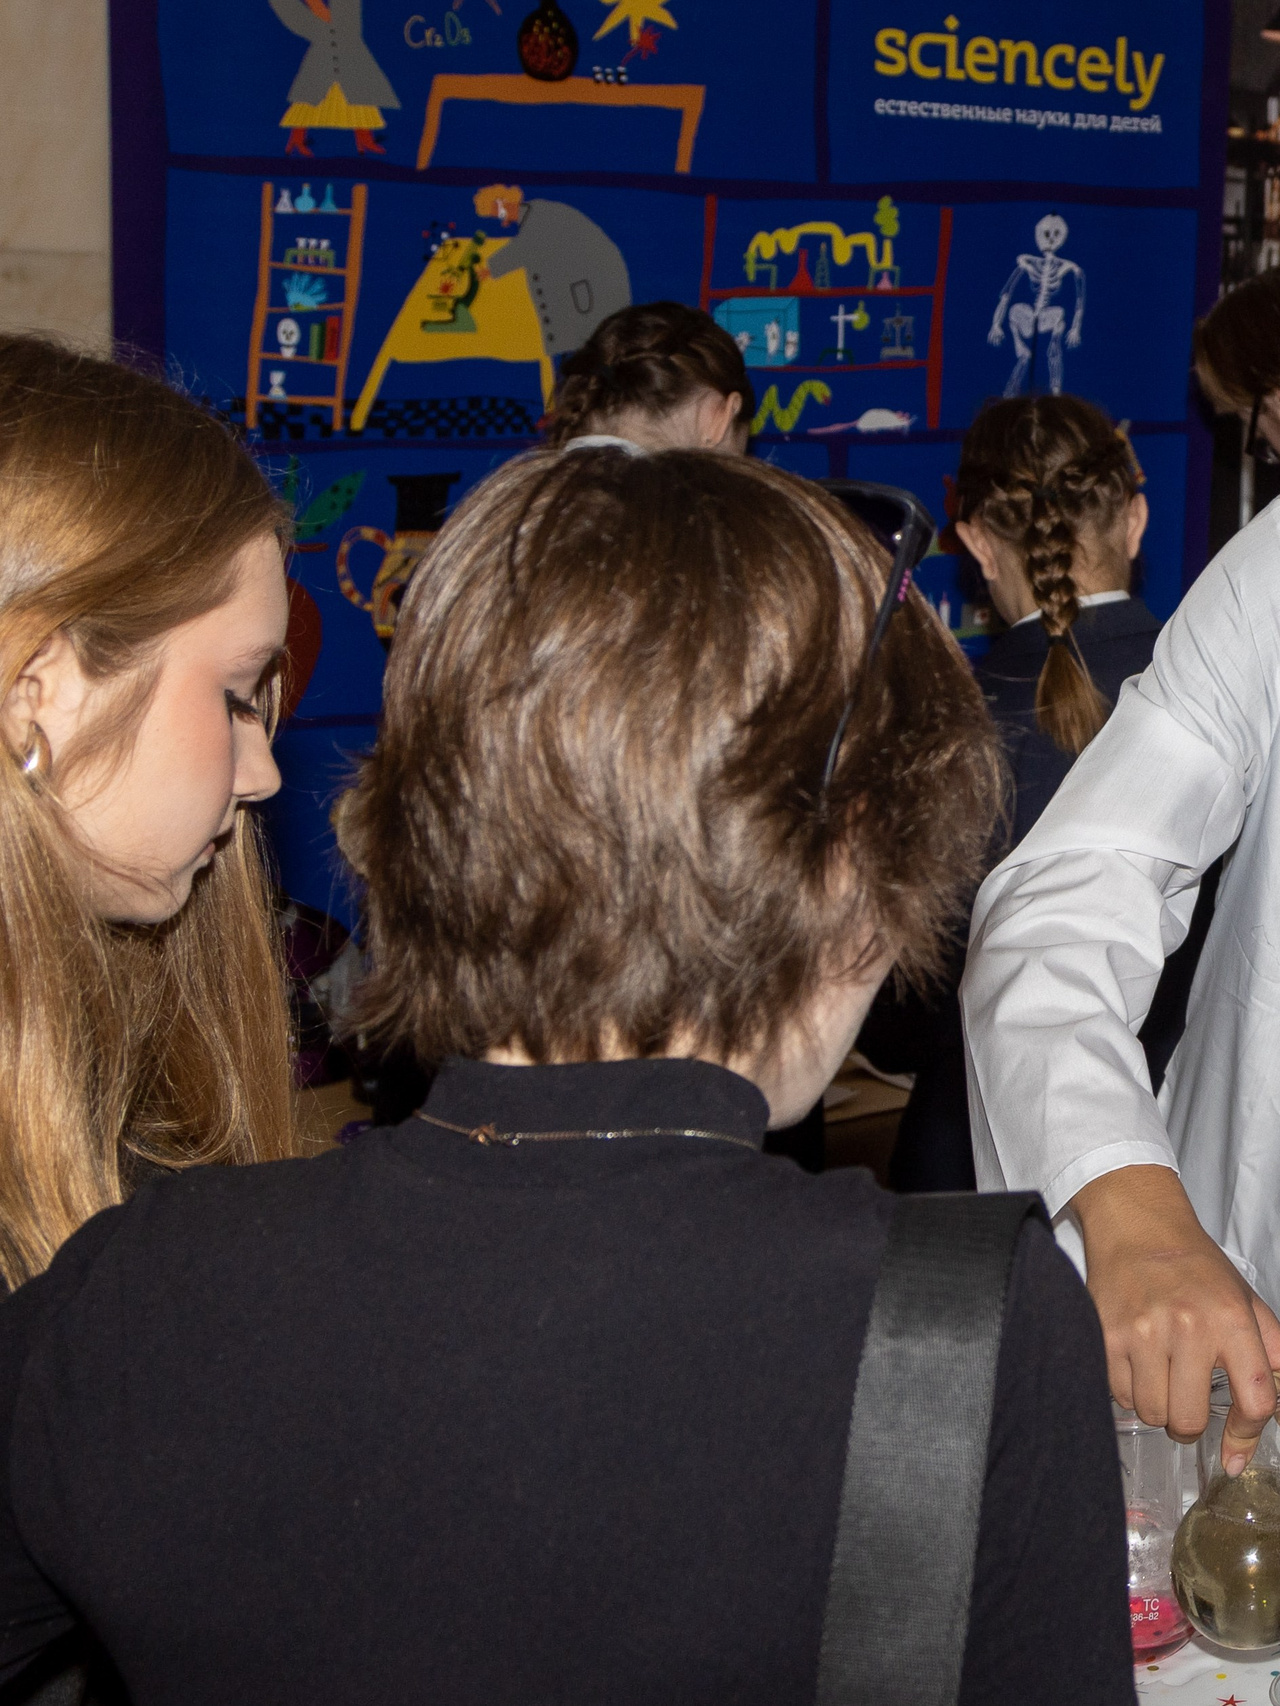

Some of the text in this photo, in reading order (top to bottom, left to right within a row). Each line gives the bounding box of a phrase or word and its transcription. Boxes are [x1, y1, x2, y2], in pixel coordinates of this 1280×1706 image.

[874, 14, 1166, 111] sciencely
[874, 98, 1162, 133] естественные науки для детей
[1130, 1612, 1159, 1622] 36-82
